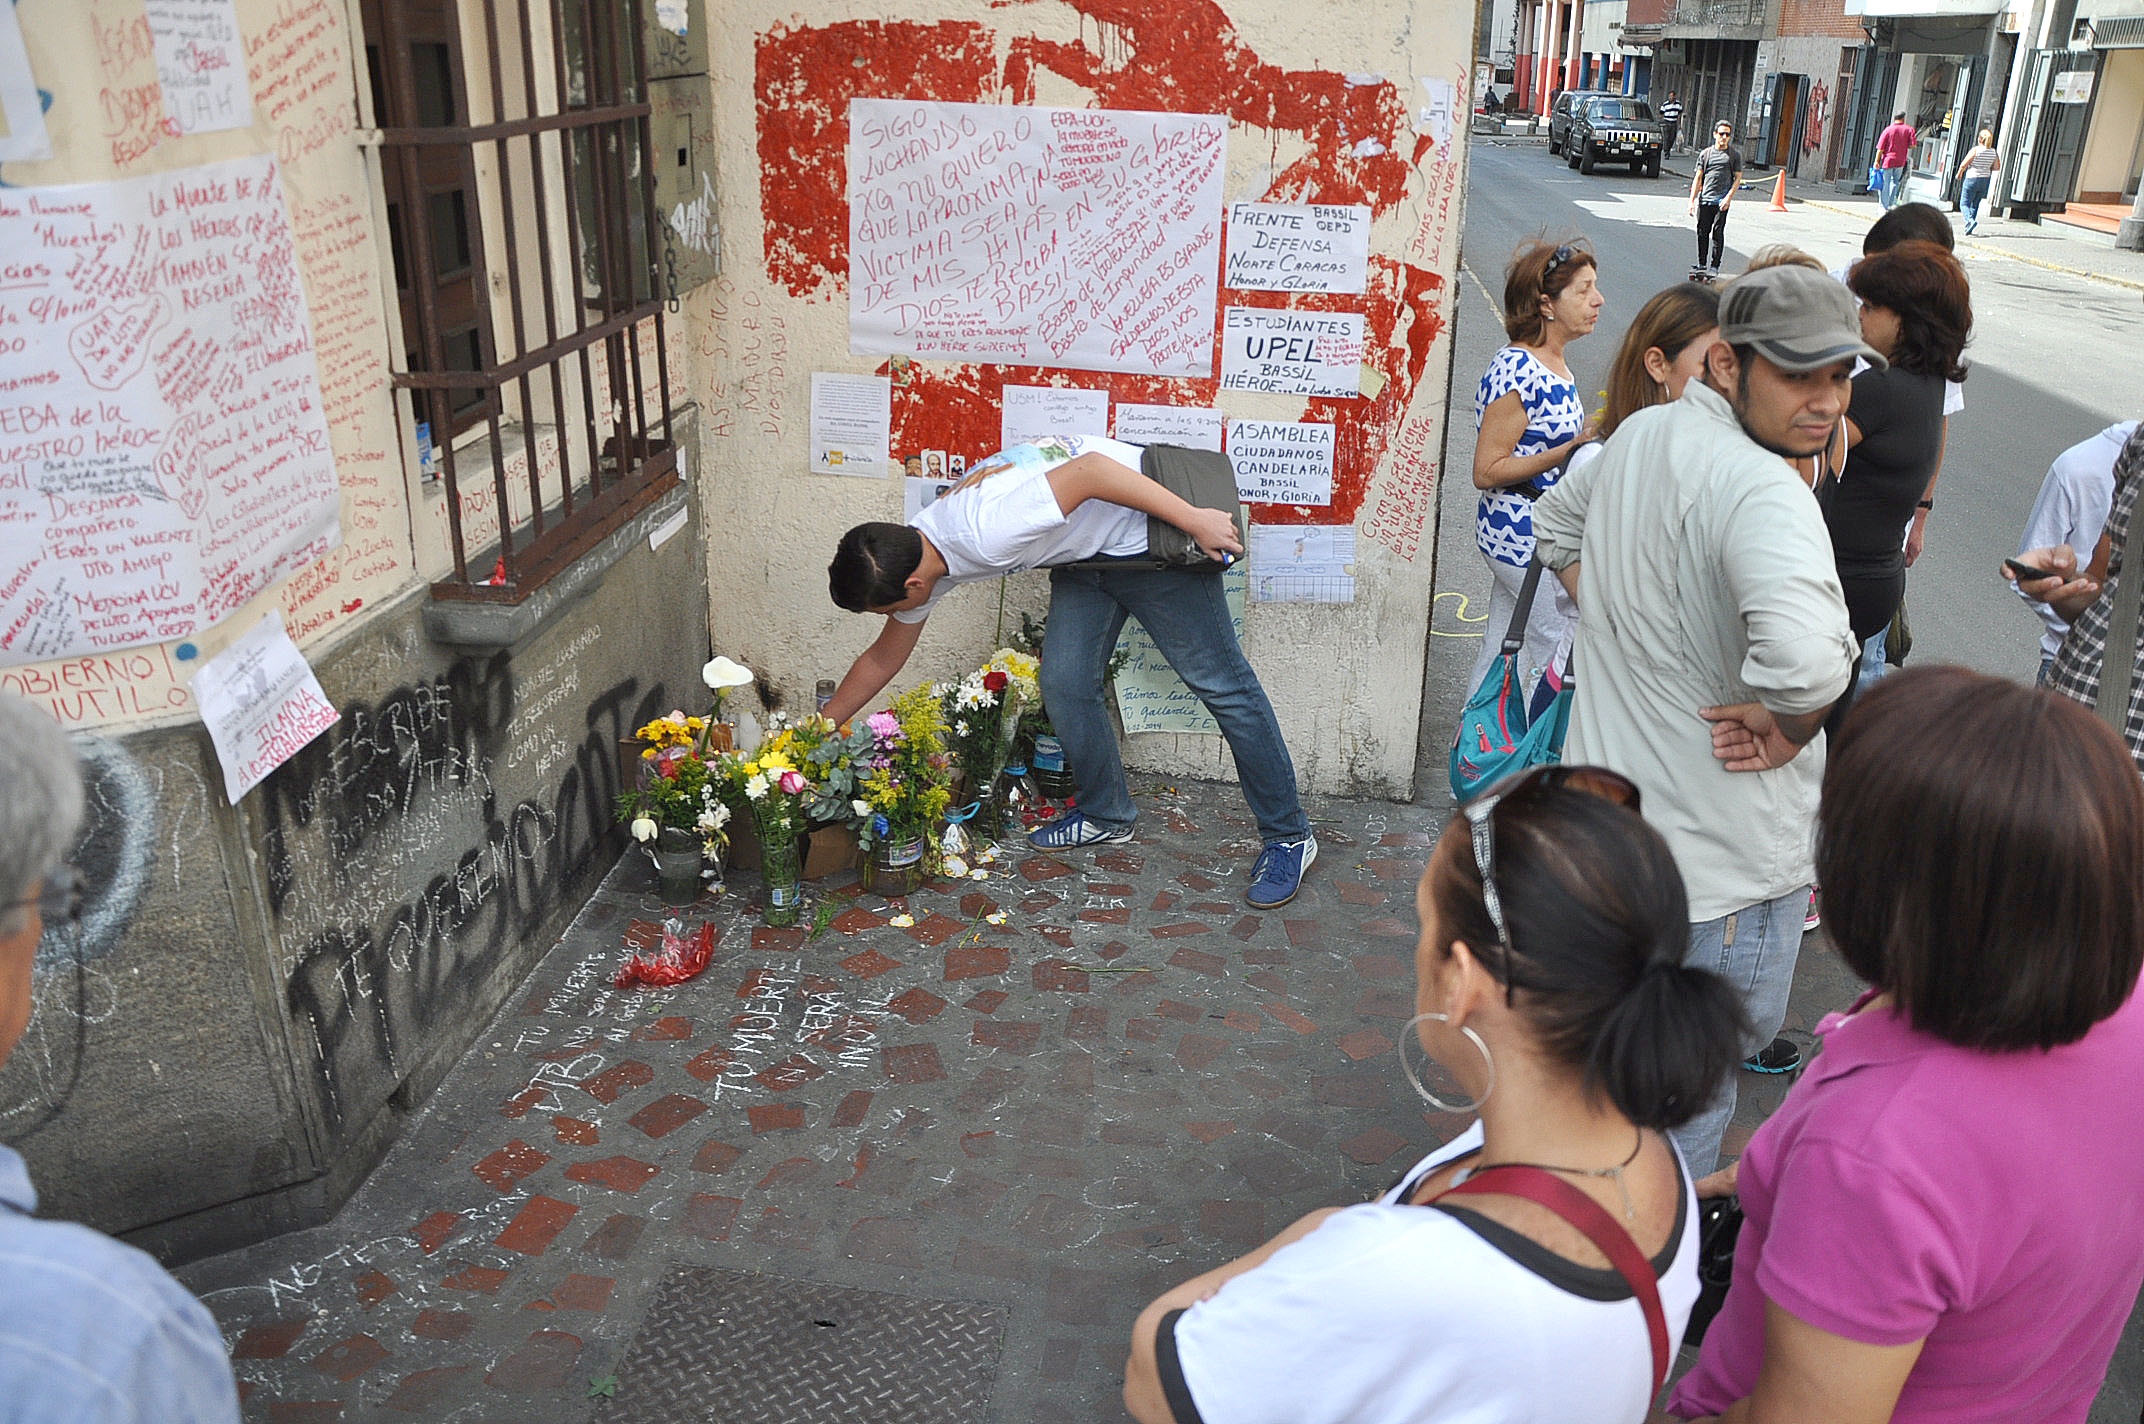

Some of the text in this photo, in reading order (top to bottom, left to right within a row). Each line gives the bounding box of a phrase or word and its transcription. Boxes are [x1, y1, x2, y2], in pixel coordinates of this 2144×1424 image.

[862, 108, 927, 149] SIGO
[859, 113, 977, 184] LUCHANDO
[941, 115, 1032, 192] QUIERO
[858, 215, 899, 245] QUE
[905, 206, 929, 239] LA
[1232, 204, 1359, 230] FRENTE BASSIL
[859, 201, 1018, 284] VICTIMA SEA
[1252, 230, 1332, 256] DEFENSA
[1411, 212, 1433, 260] JAMAS
[1228, 251, 1348, 275] NORTE CARACAS
[860, 277, 900, 314] DE
[912, 258, 967, 293] MIS
[883, 292, 961, 336] DIOS
[1227, 309, 1351, 336] ESTUDIANTES
[1246, 336, 1322, 364] UPEL
[1260, 363, 1317, 382] BASSIL
[1231, 423, 1330, 445] ASAMBLEA
[1233, 444, 1325, 461] CIUDADANOS
[1236, 461, 1330, 477] CANDELARIA
[1260, 478, 1300, 489] BASSIL
